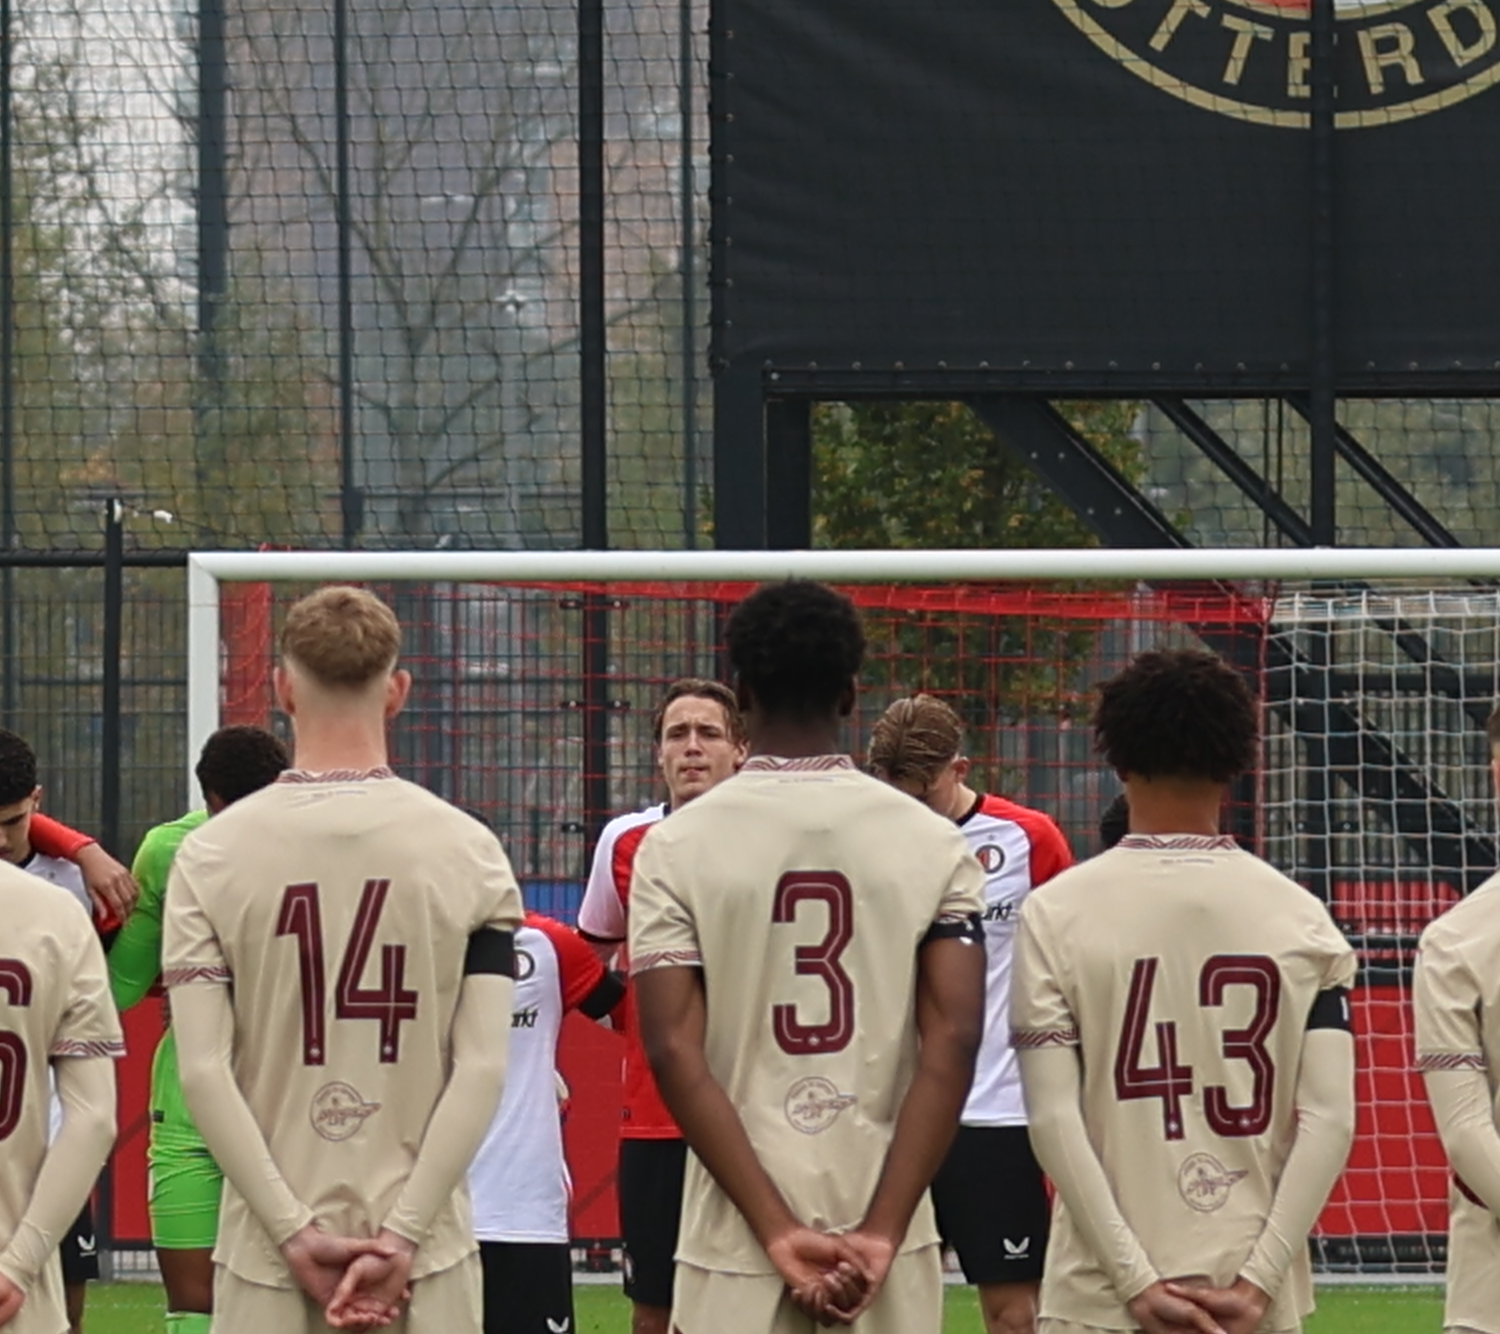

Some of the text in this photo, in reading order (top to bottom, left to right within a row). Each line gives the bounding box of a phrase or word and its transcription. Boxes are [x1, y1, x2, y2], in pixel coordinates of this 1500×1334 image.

[275, 879, 418, 1066] 14
[772, 870, 855, 1055] 3
[1115, 954, 1281, 1141] 43
